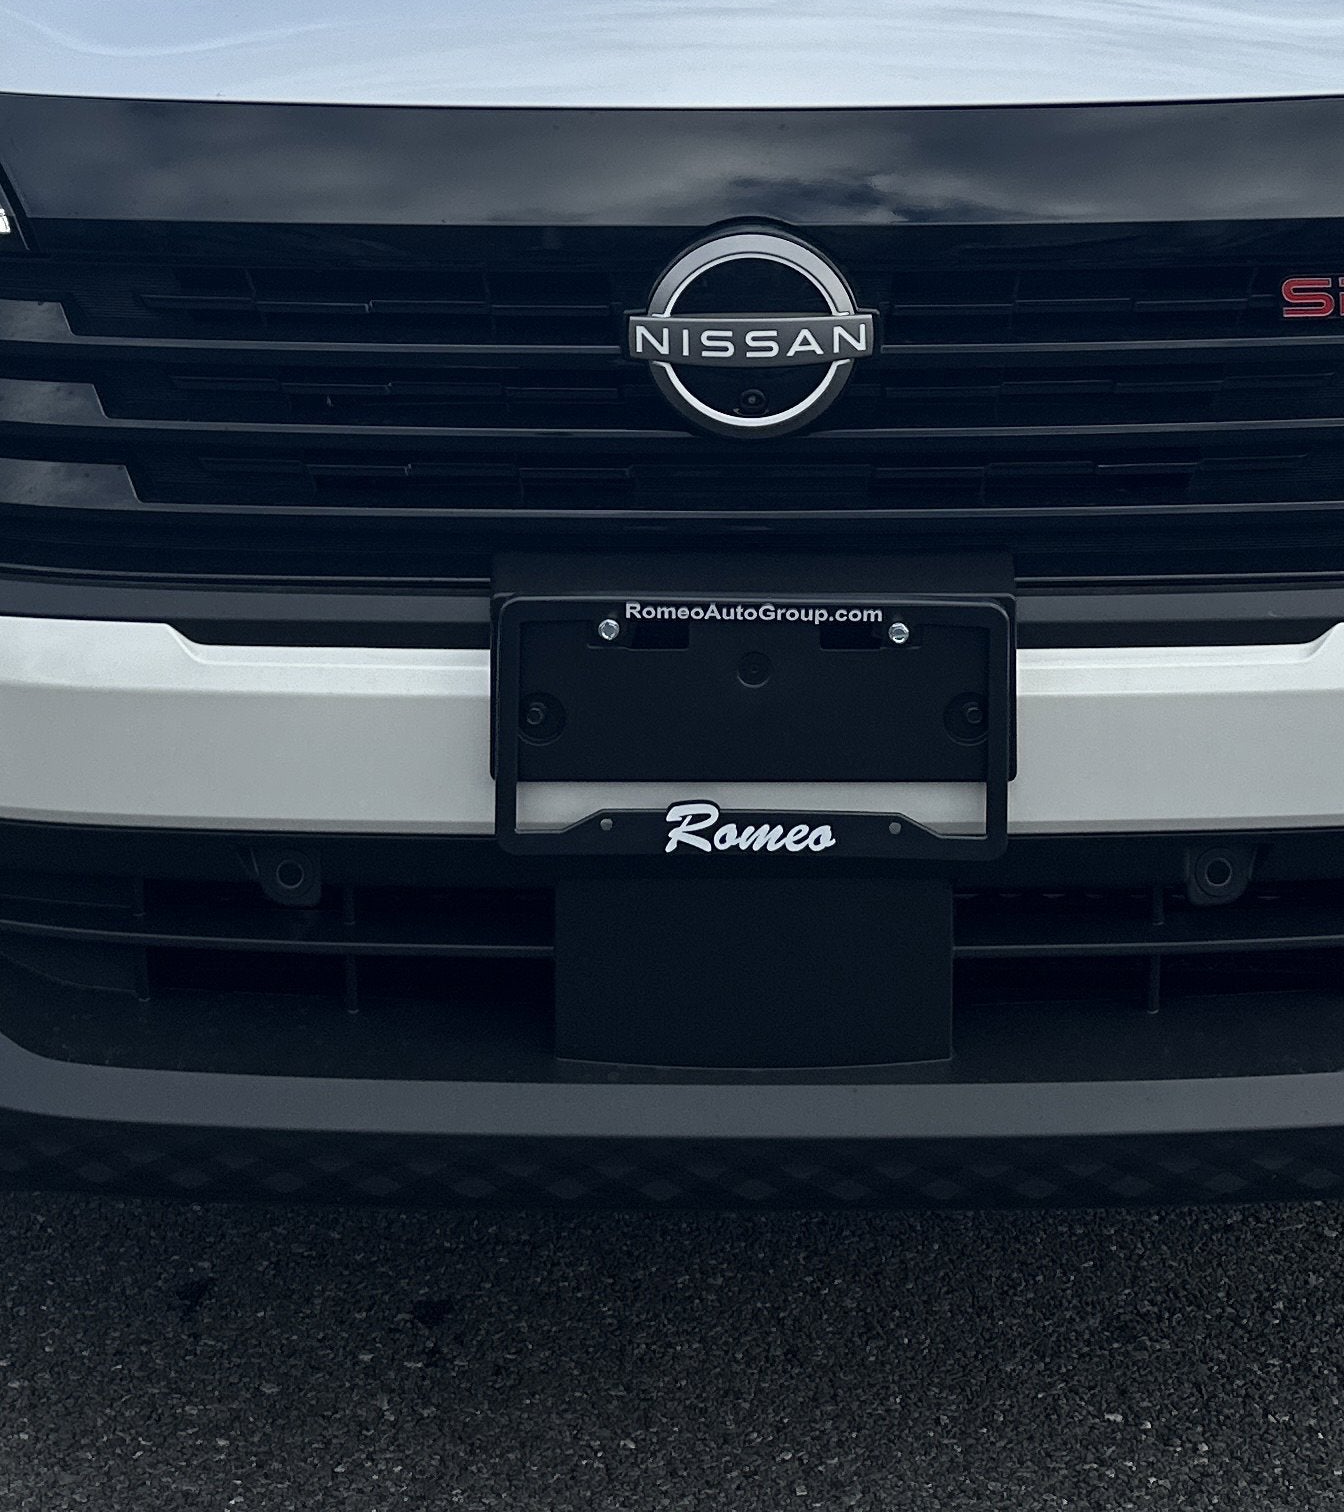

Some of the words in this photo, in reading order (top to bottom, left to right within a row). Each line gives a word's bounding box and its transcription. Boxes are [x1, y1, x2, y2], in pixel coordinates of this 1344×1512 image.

[636, 324, 866, 357] NISSAN
[625, 602, 883, 625] RomeoAutoGroup.com
[665, 804, 836, 852] Romeo
